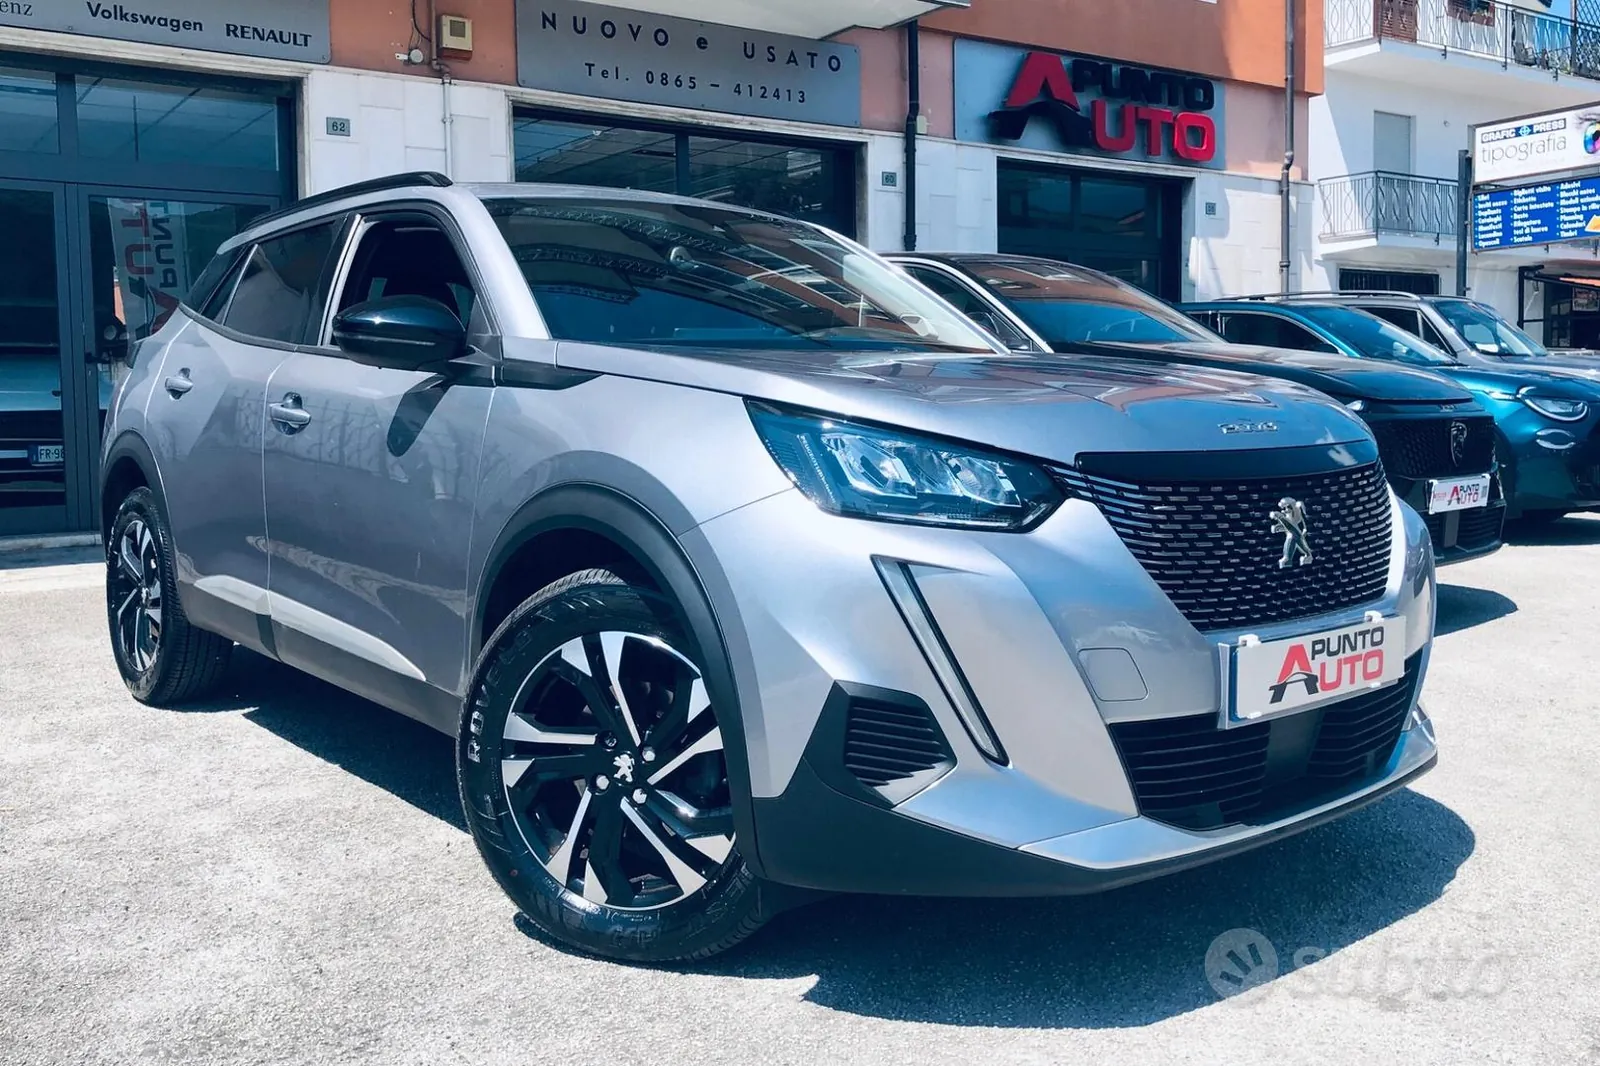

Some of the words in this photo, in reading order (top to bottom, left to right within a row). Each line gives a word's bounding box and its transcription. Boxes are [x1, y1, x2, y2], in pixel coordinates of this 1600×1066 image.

[87, 1, 203, 33] Volkswagen
[225, 23, 312, 48] RENAULT
[541, 11, 669, 47] NUOVO
[696, 36, 709, 50] e
[743, 41, 841, 72] USATO
[584, 62, 630, 81] Tel.
[646, 71, 697, 90] 0865
[733, 83, 806, 103] 412413
[331, 121, 346, 132] 62
[1482, 129, 1516, 142] GRAFIC
[1533, 120, 1565, 133] PRESS
[1482, 133, 1567, 165] tipografia
[1311, 626, 1384, 660] PUNTO
[1269, 643, 1384, 704] AUTO
